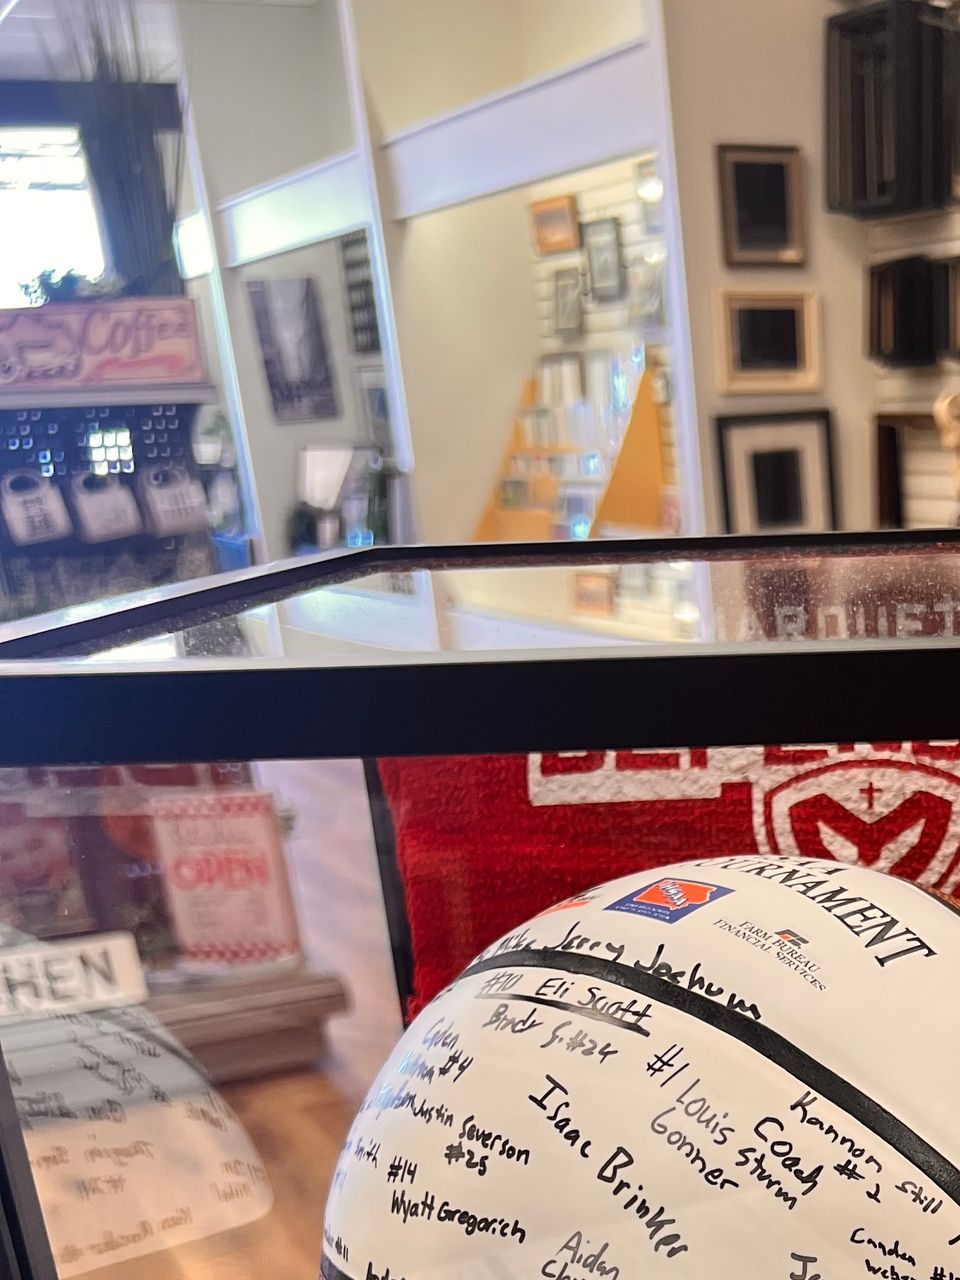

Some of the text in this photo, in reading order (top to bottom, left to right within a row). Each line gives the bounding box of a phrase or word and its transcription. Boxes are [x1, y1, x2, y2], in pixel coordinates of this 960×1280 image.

[172, 855, 271, 890] OPEN
[713, 919, 825, 991] FINANCIAL SERVICES
[739, 920, 820, 973] FARM BUREAU
[535, 977, 575, 999] Eli
[528, 1074, 593, 1159] Isaac
[675, 1078, 735, 1145] Louis
[387, 1155, 417, 1185] #14
[444, 1142, 489, 1176] #25
[753, 1116, 824, 1195] Coach
[391, 1189, 435, 1224] Wyatt
[597, 1146, 688, 1259] Brinker
